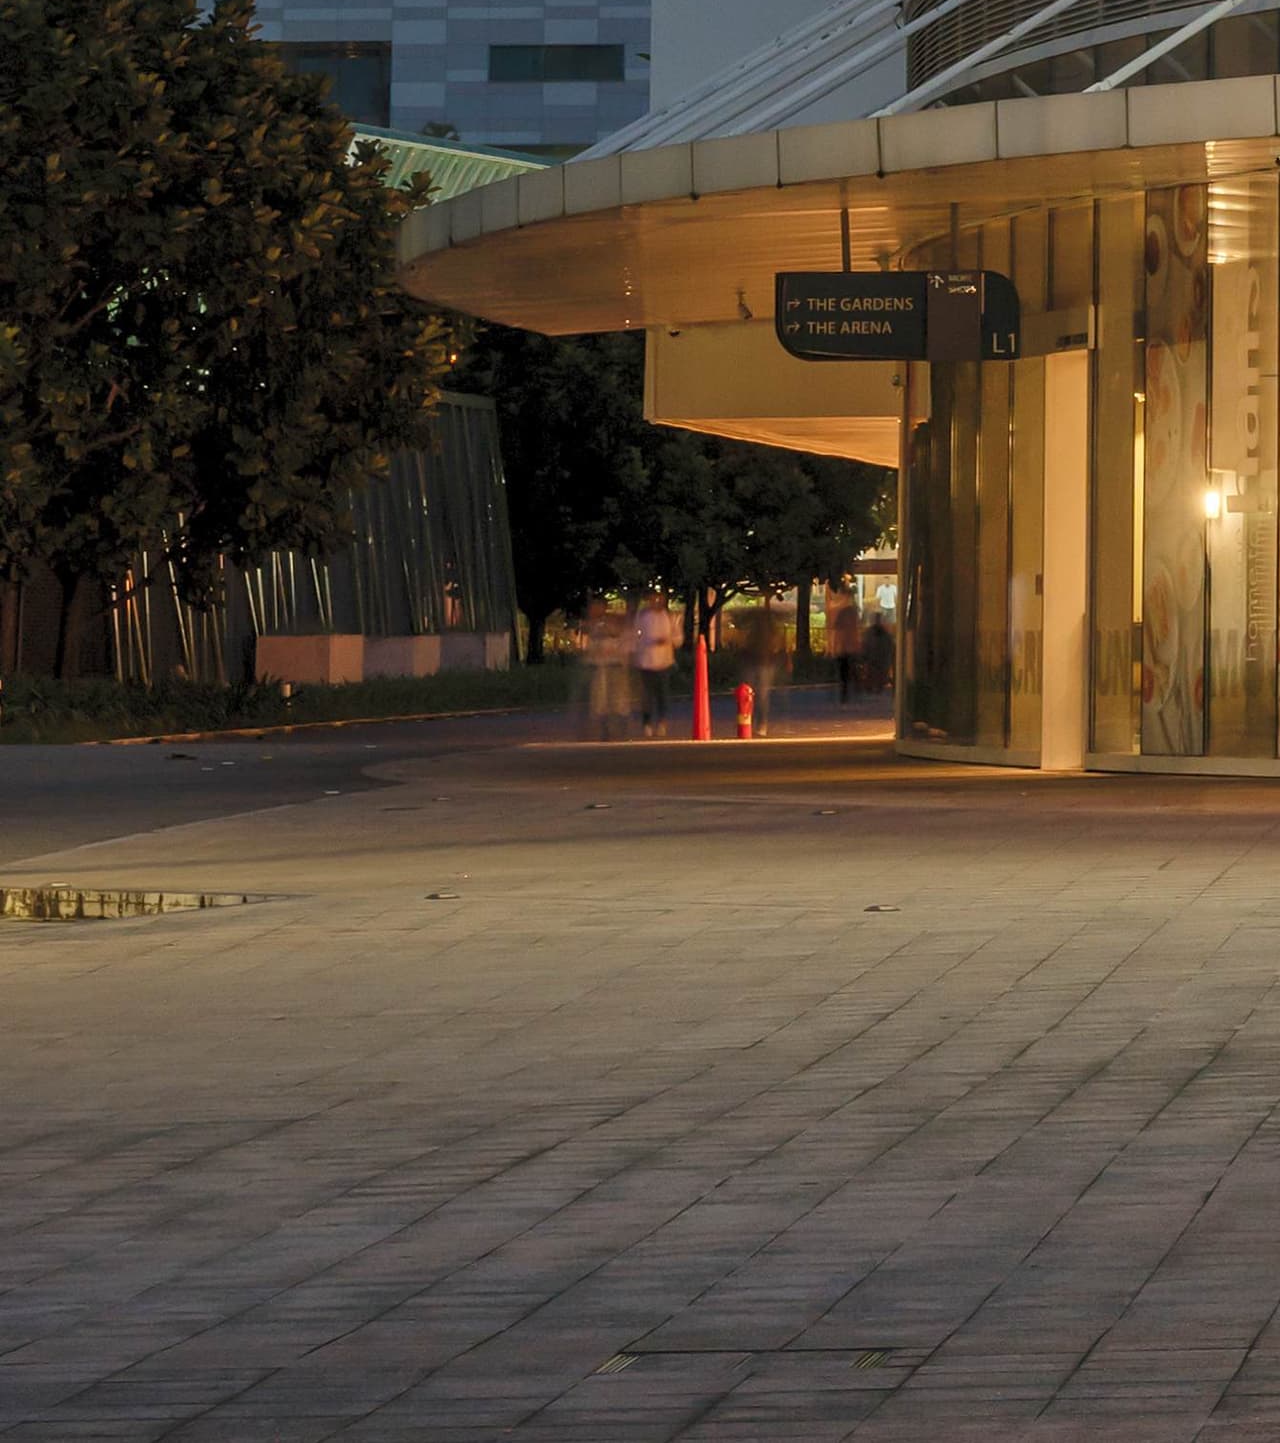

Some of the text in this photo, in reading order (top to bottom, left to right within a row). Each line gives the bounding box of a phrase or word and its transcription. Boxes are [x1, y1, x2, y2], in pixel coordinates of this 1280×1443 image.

[806, 296, 915, 312] THE GARDENS
[806, 320, 893, 335] THE ARENA
[991, 331, 1018, 354] L1
